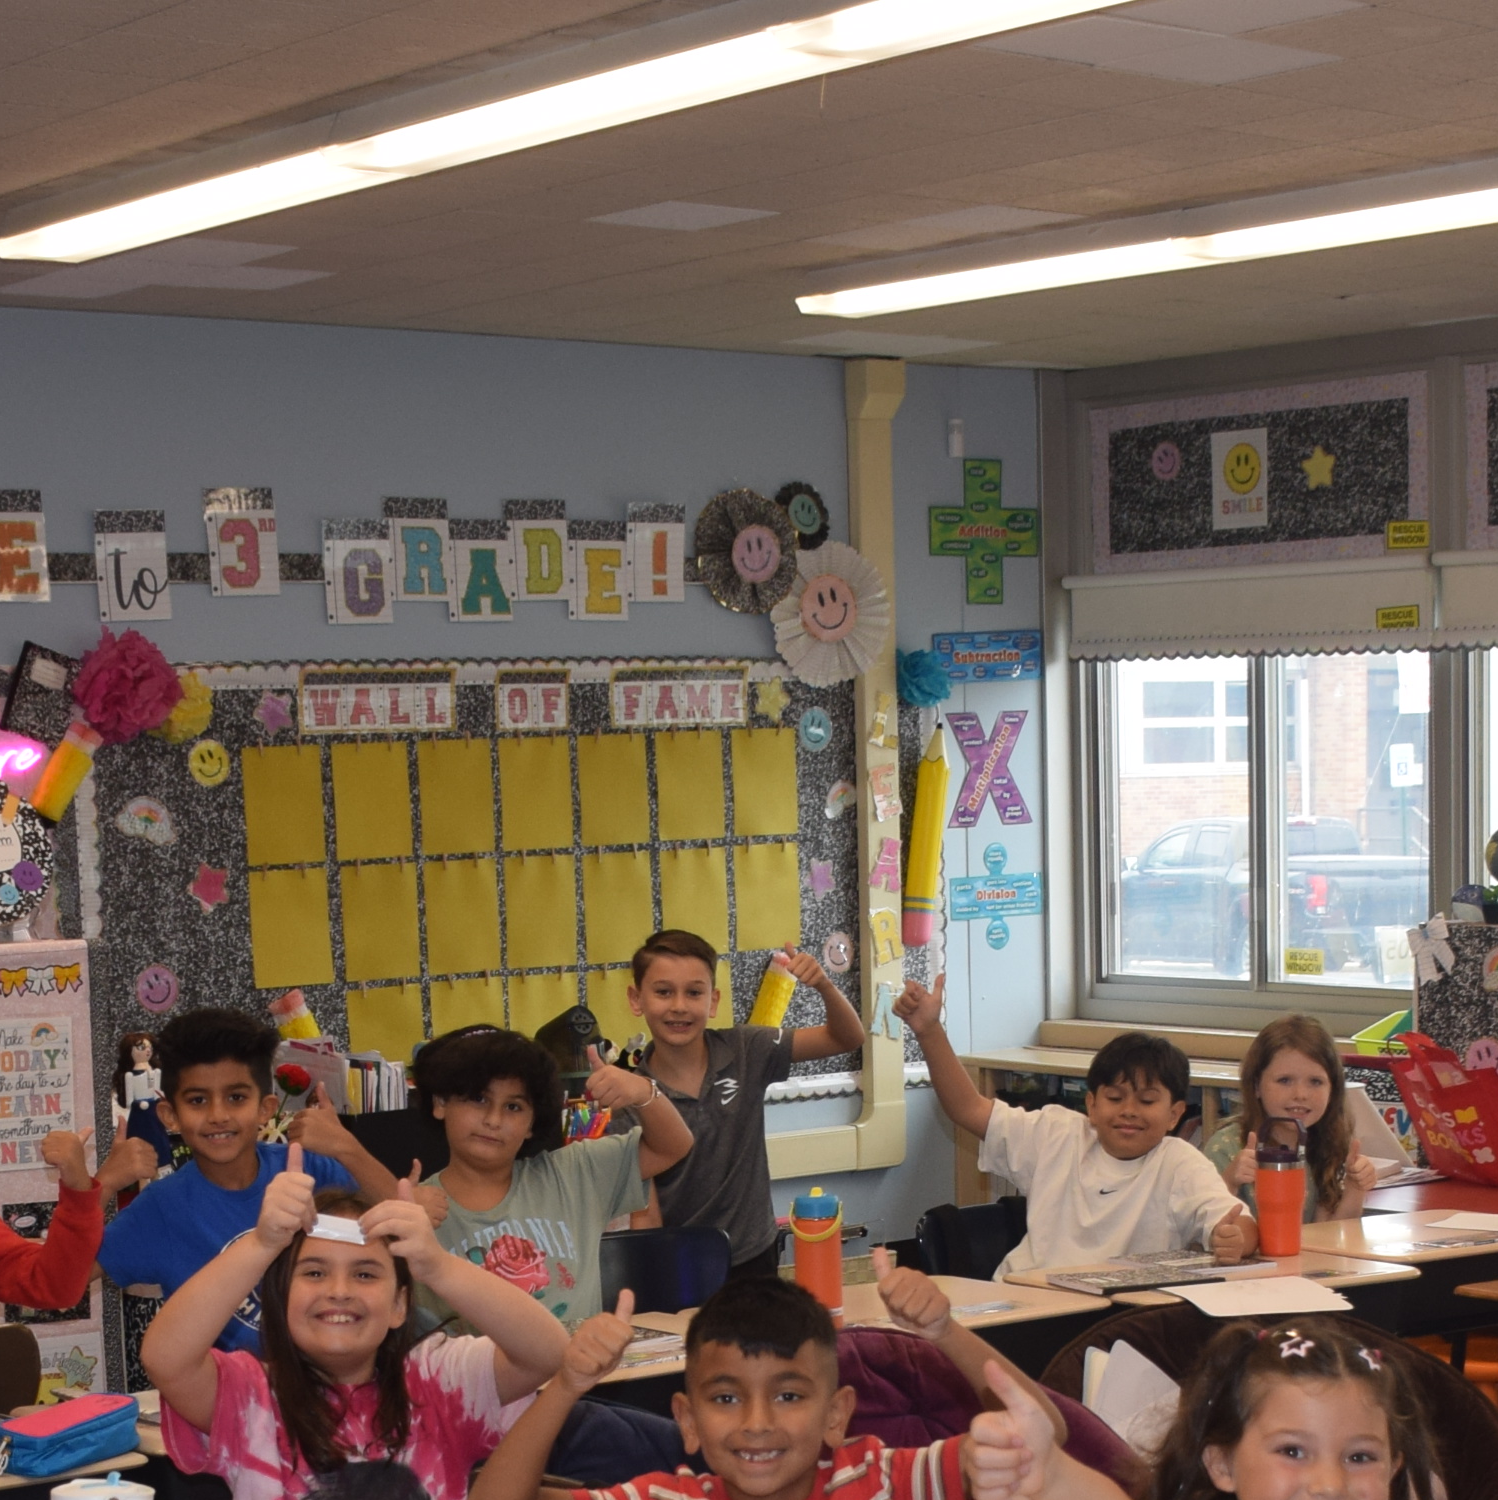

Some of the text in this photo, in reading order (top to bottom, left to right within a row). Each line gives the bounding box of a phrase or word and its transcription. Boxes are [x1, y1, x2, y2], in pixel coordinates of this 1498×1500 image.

[1221, 497, 1263, 515] SMILE
[958, 524, 1009, 538] Addition
[1392, 523, 1425, 534] RESCUE
[1392, 535, 1426, 544] WINDOW
[107, 546, 169, 612] to
[343, 526, 669, 618] GRADE!
[1381, 610, 1414, 620] RESCUE
[953, 650, 1021, 665] Subtraction
[309, 684, 740, 728] WALL OF FAME
[966, 724, 1011, 811] Multiplication
[976, 889, 1017, 901] Division
[1289, 952, 1319, 962] RESCUE
[1286, 962, 1323, 973] WINDOW
[15, 1073, 35, 1096] day
[36, 1072, 48, 1088] to
